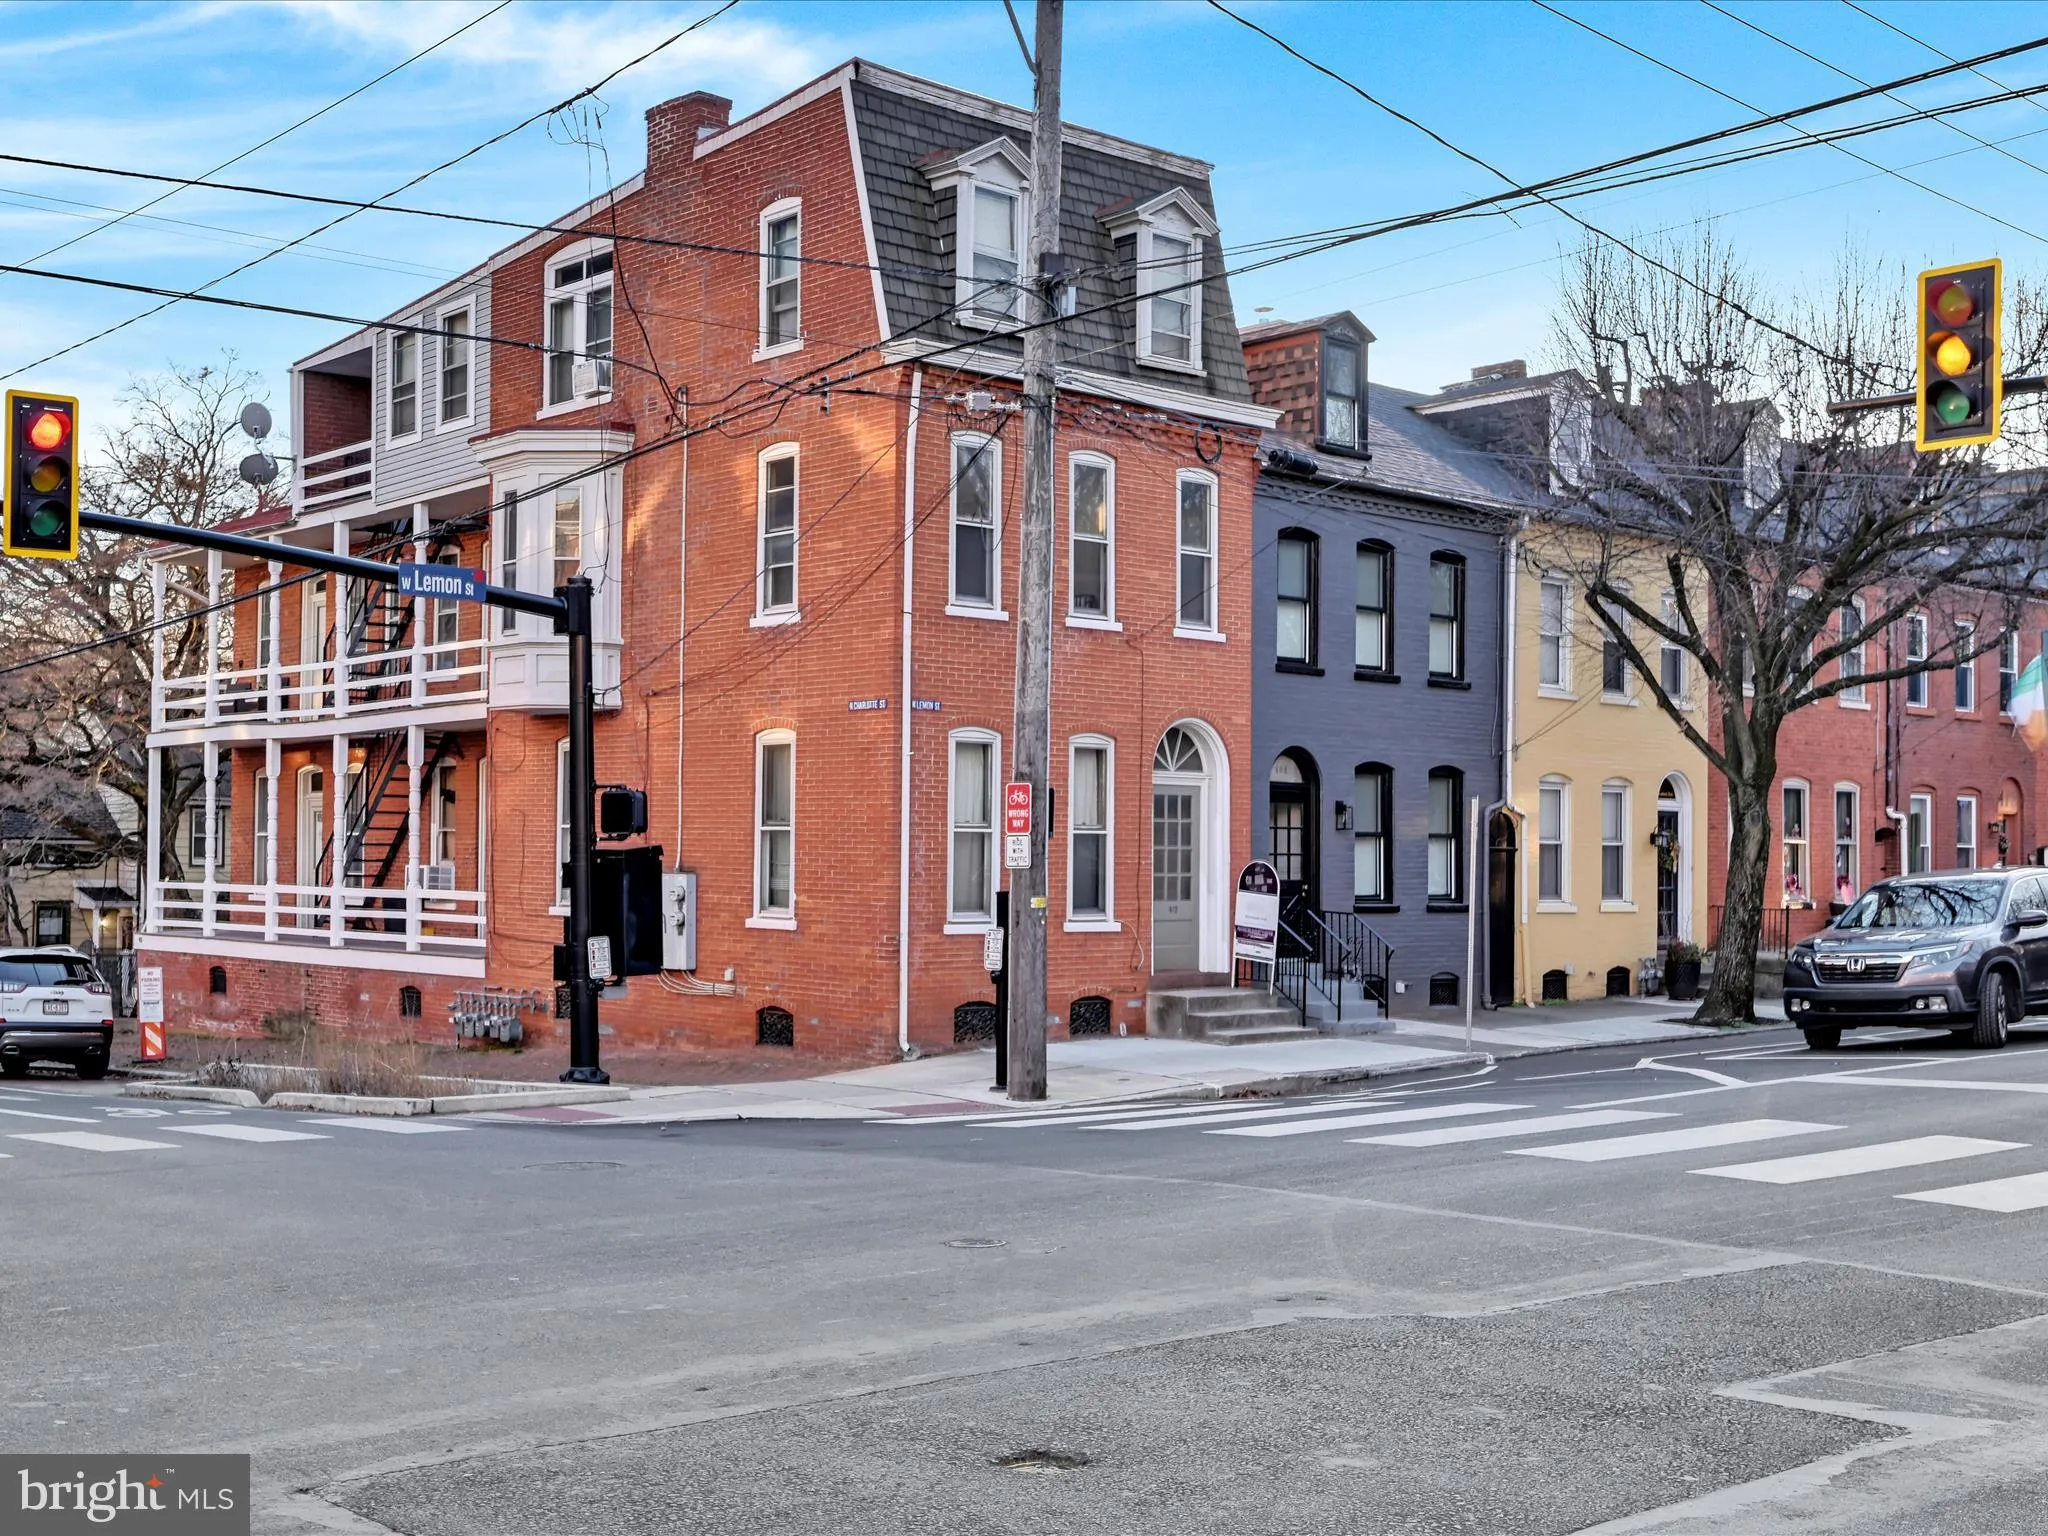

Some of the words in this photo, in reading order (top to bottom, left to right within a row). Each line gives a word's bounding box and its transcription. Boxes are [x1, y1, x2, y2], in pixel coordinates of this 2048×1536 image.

[414, 569, 462, 595] Lemon
[465, 583, 474, 597] St
[916, 701, 934, 711] LEMON
[1008, 809, 1029, 818] WRONG
[1012, 819, 1025, 828] WAY
